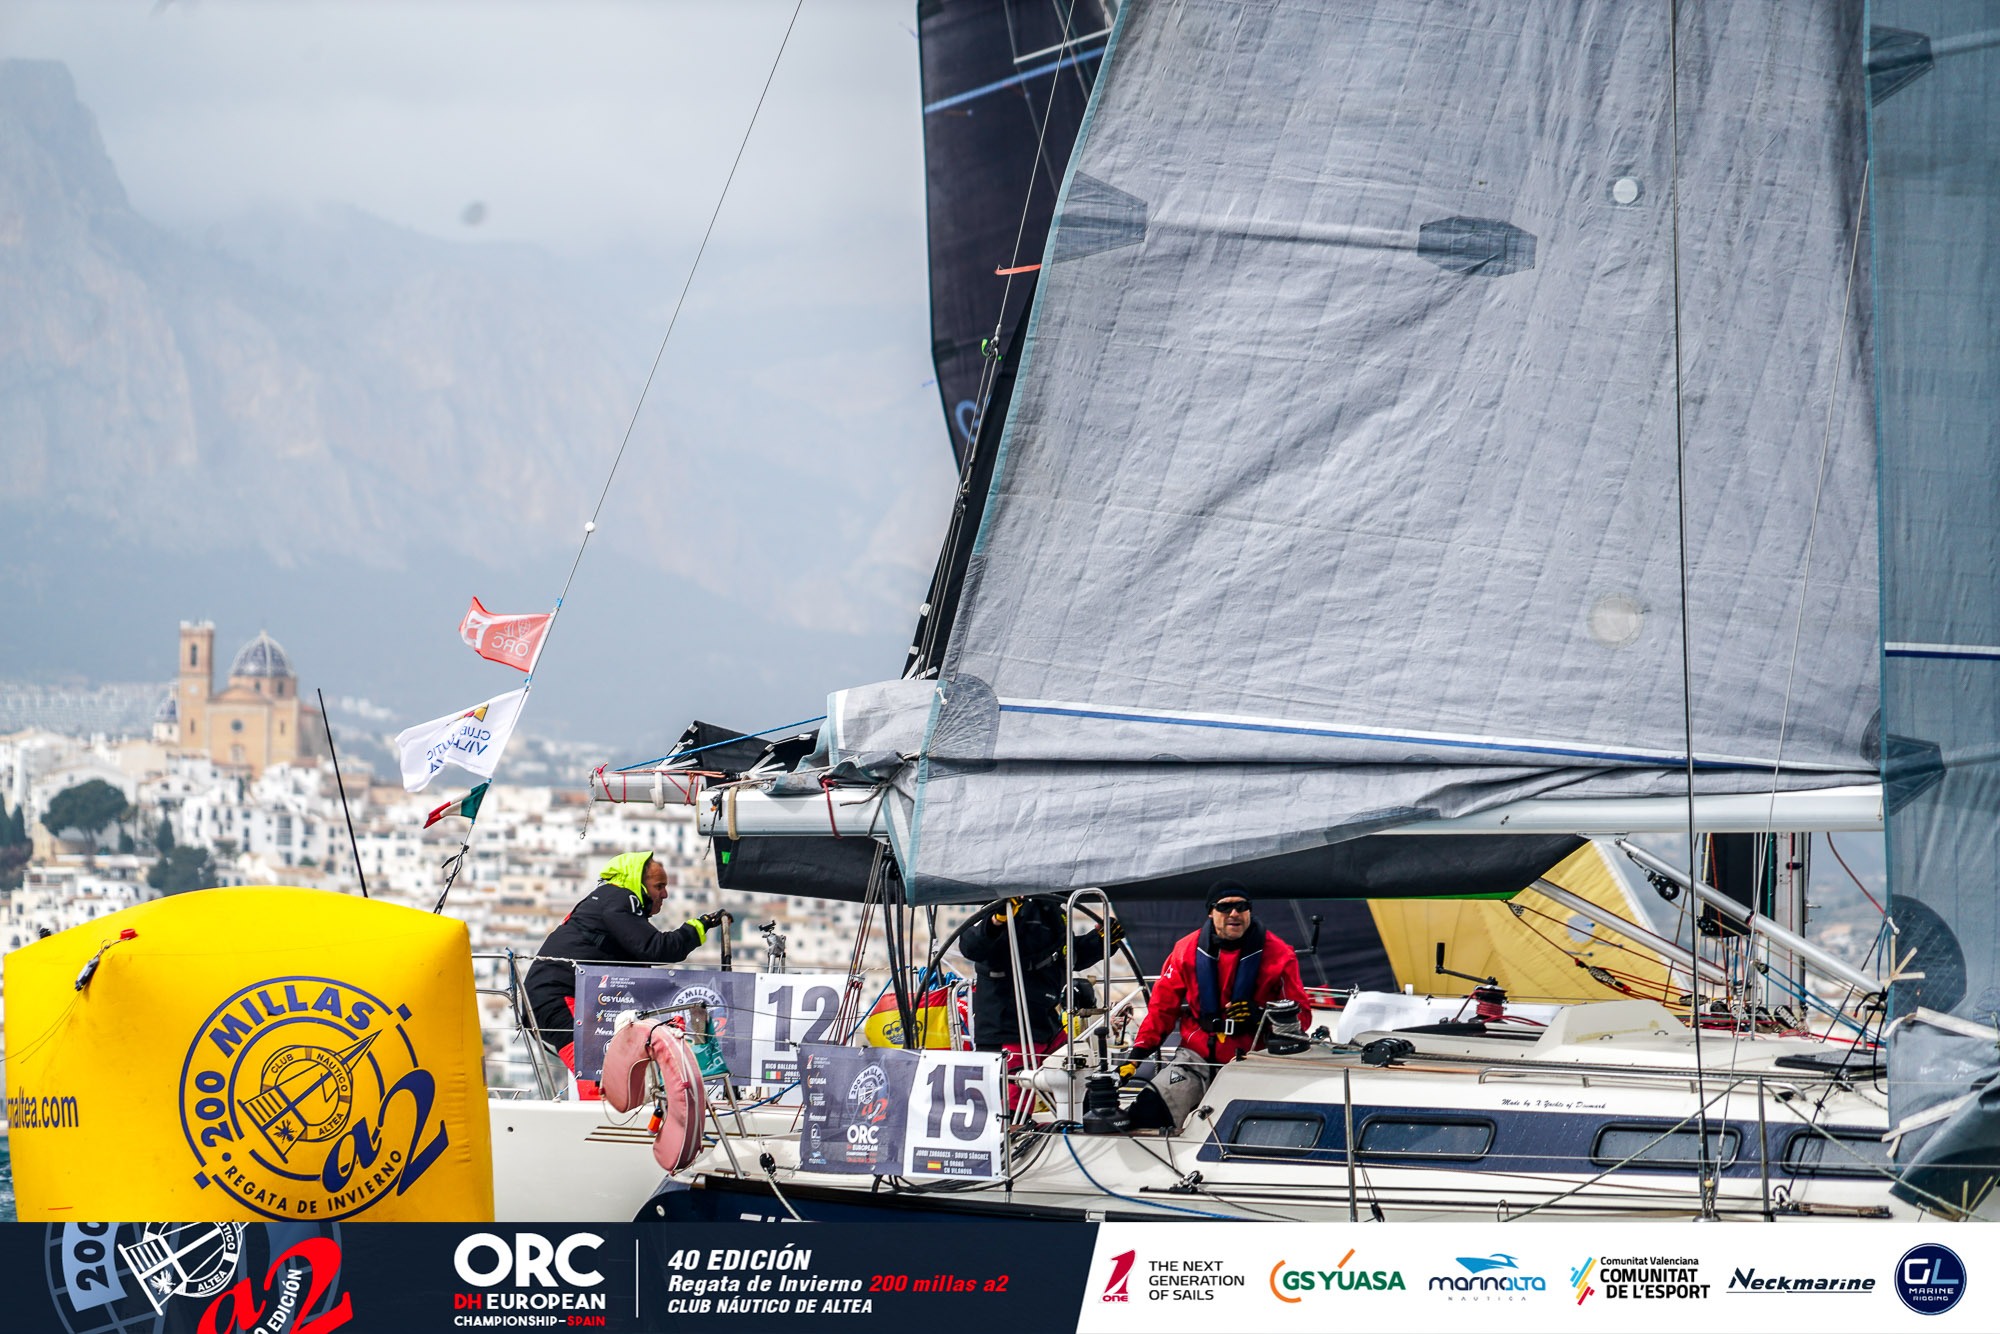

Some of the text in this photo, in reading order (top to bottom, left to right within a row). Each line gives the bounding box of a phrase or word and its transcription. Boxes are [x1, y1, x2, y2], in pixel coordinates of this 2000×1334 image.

[768, 986, 841, 1052] 12
[195, 985, 375, 1147] 200 MILLAS
[271, 1053, 349, 1093] CLUB NÁUTICO
[319, 1112, 345, 1136] ALTEA
[322, 1069, 449, 1196] a2
[846, 1124, 880, 1145] ORC
[927, 1065, 989, 1141] 15
[1523, 1099, 1531, 1107] by
[224, 1150, 403, 1214] REGATA DE INVIERNO
